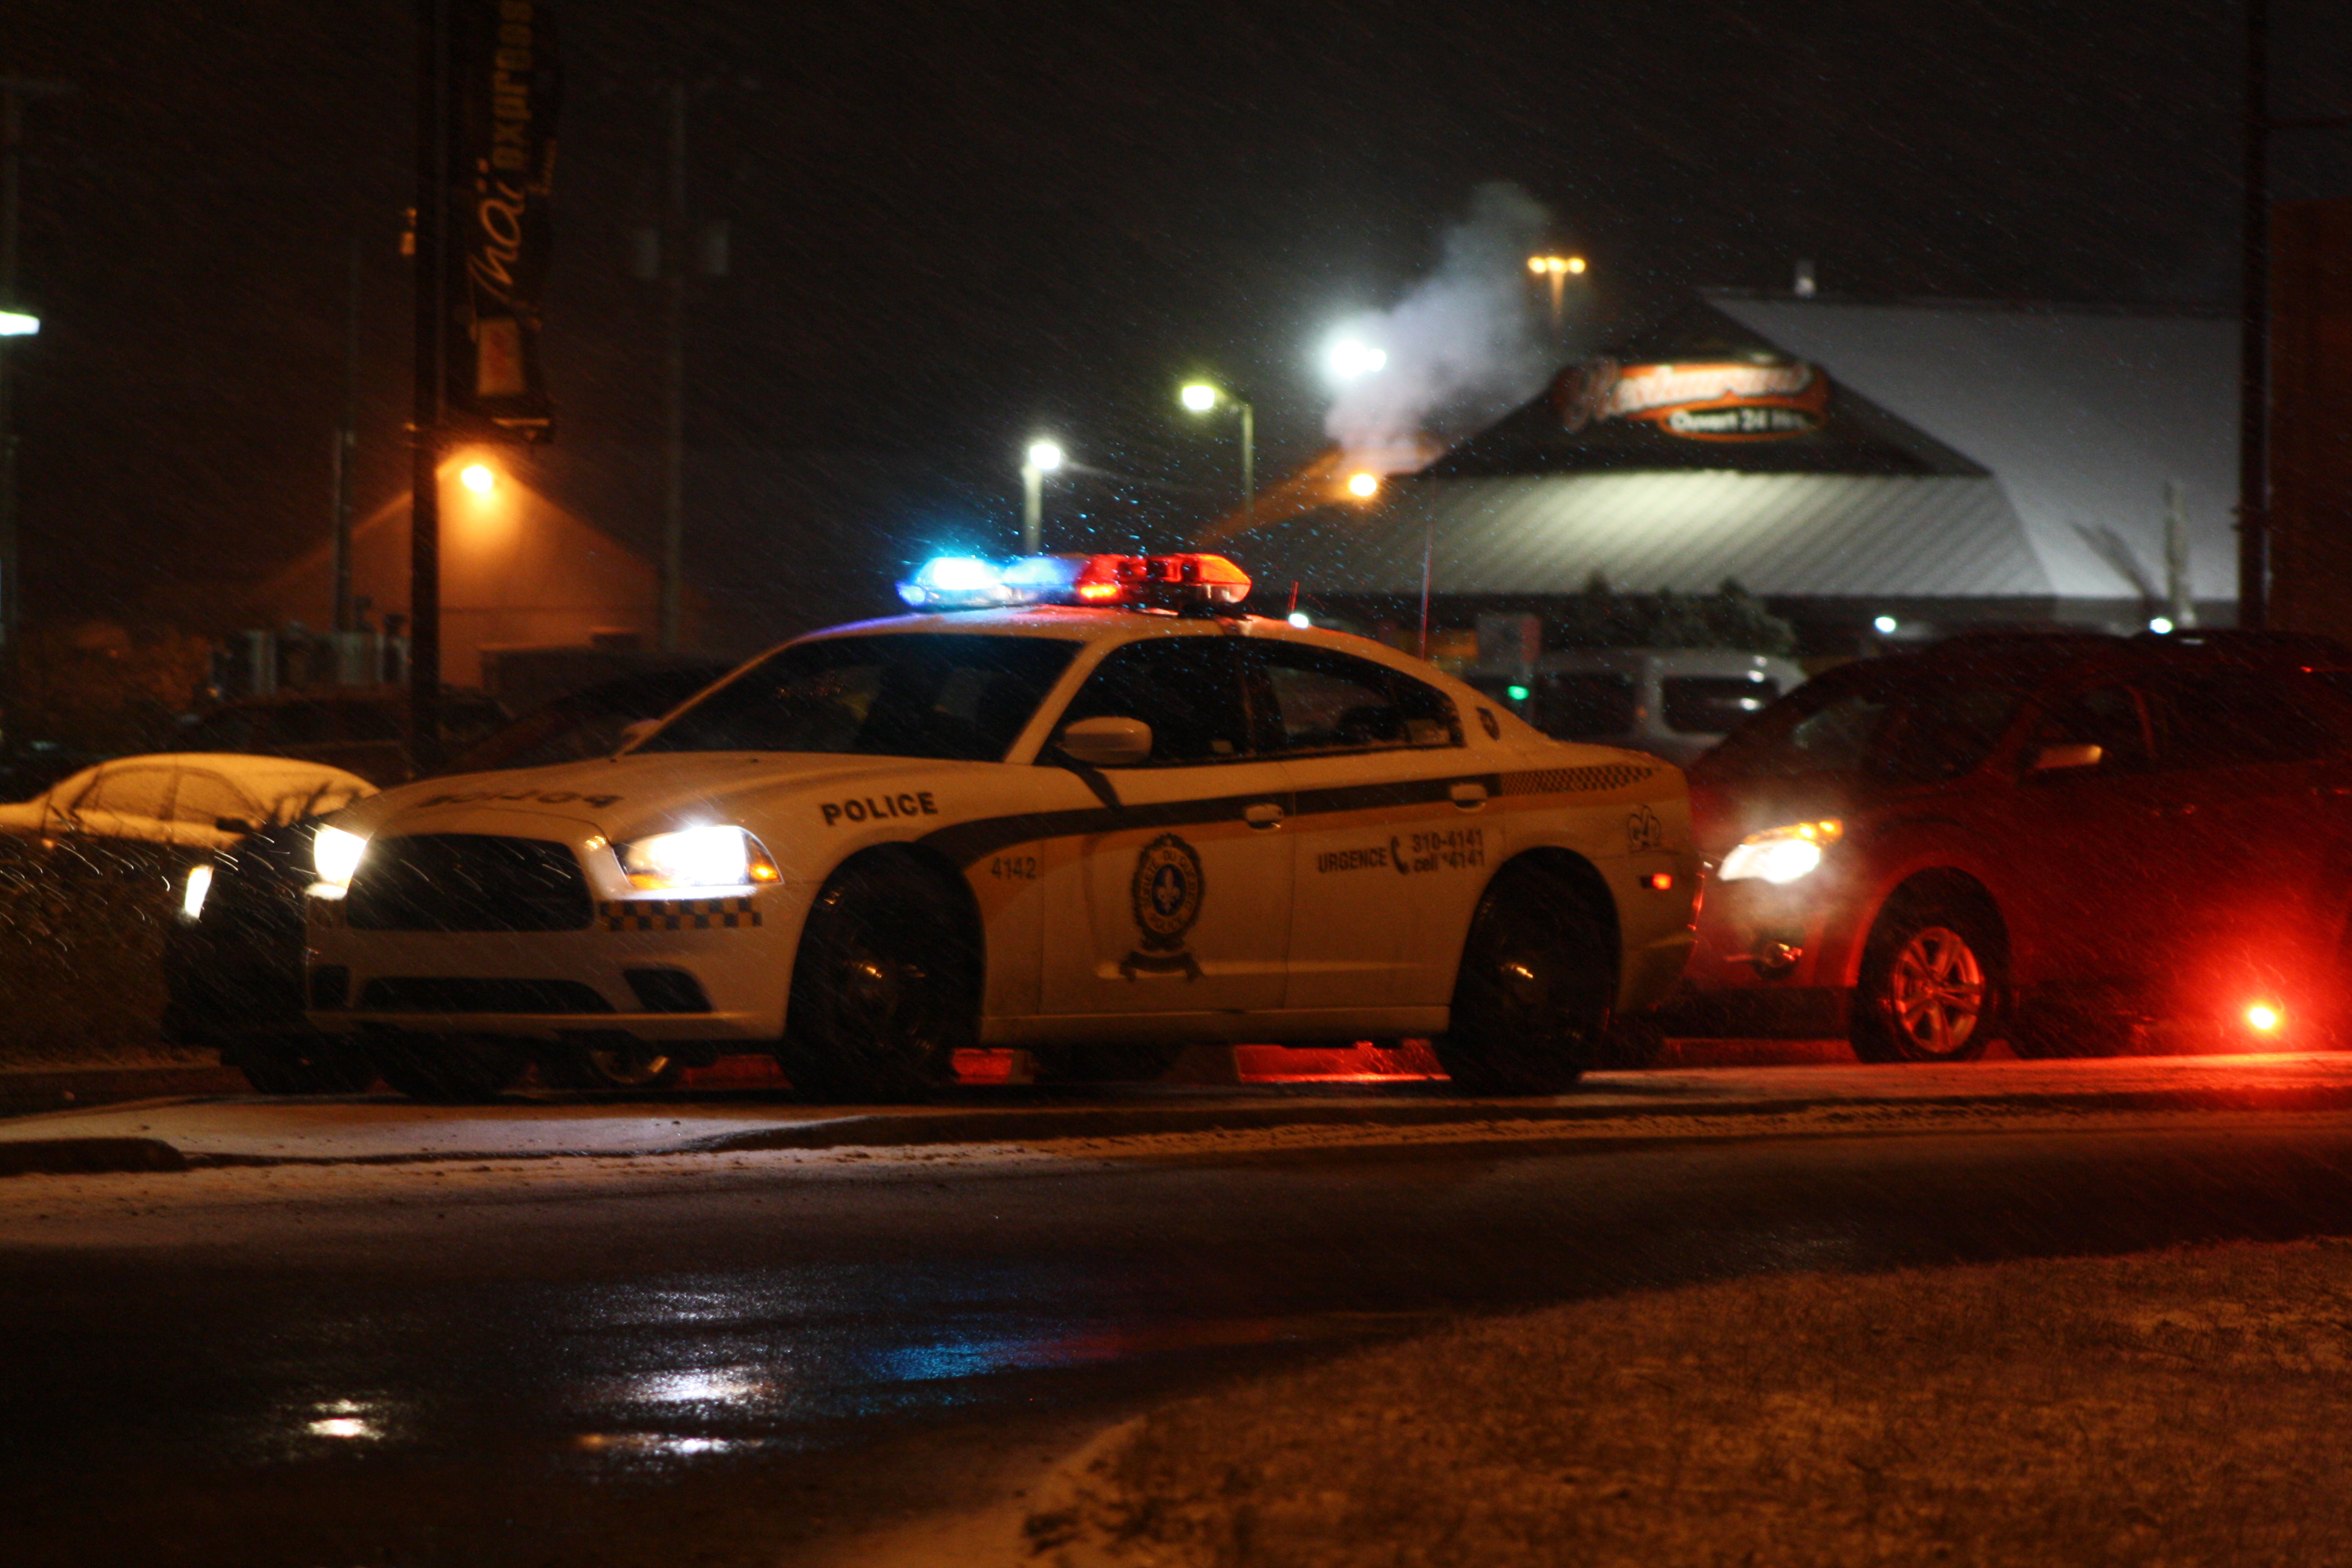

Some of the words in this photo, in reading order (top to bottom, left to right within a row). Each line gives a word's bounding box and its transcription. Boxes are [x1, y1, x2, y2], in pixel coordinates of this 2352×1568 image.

[821, 792, 938, 826] POLICE
[1411, 828, 1482, 852] 310-4141
[991, 857, 1037, 880] 4142
[1318, 847, 1387, 873] URGENCE
[1413, 853, 1437, 872] cell
